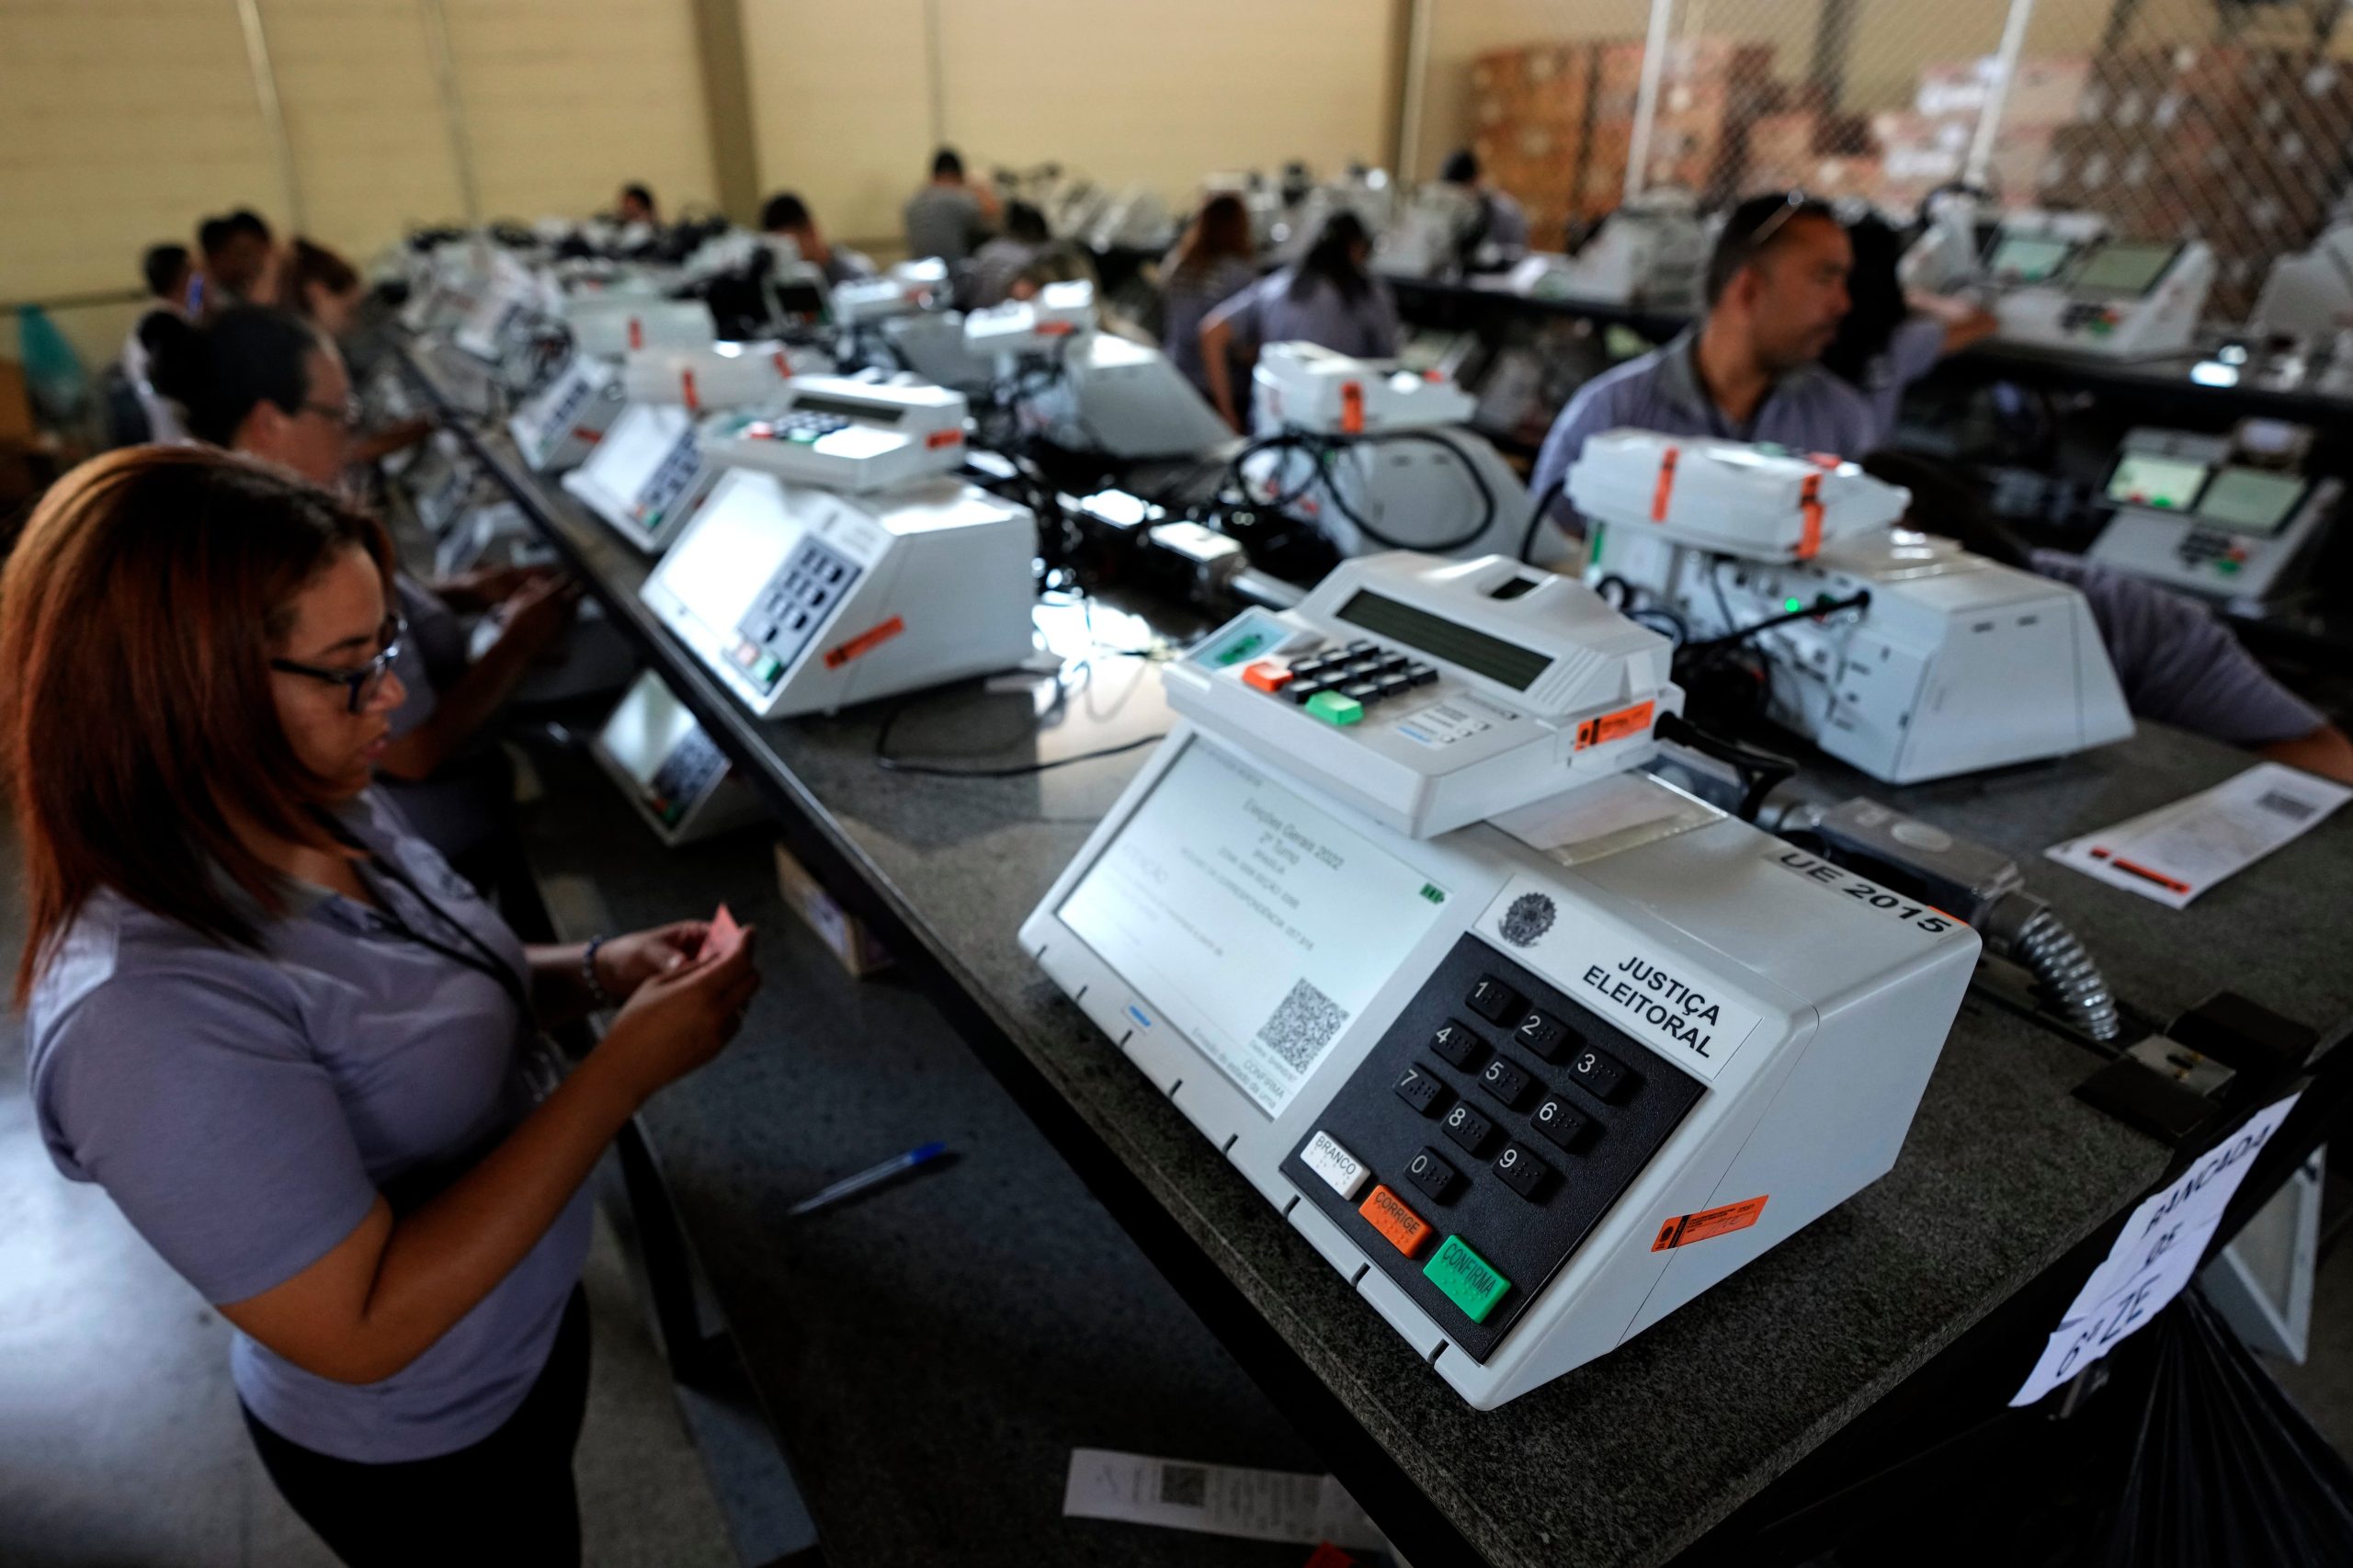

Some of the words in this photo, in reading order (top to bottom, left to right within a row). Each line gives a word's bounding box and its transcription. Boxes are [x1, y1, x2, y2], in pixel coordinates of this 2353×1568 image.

[1780, 853, 1844, 883] UE
[1842, 883, 1952, 933] 2015
[1475, 982, 1489, 998] 1
[1521, 1016, 1540, 1036] 2
[1577, 1054, 1596, 1074] 3
[1583, 965, 1711, 1058] ELEITORAL
[1618, 957, 1720, 1027] JUSTIÇA
[1436, 1028, 1452, 1043] 4
[1485, 1062, 1504, 1081] 5
[1540, 1102, 1557, 1121] 6
[1315, 1136, 1357, 1176] BRANCO
[1401, 1070, 1418, 1086] 7
[1449, 1108, 1466, 1127] 8
[1499, 1149, 1518, 1168] 9
[1411, 1155, 1427, 1174] 0
[1375, 1191, 1420, 1234] CORRIGE
[1443, 1244, 1497, 1298] CONFIRMA
